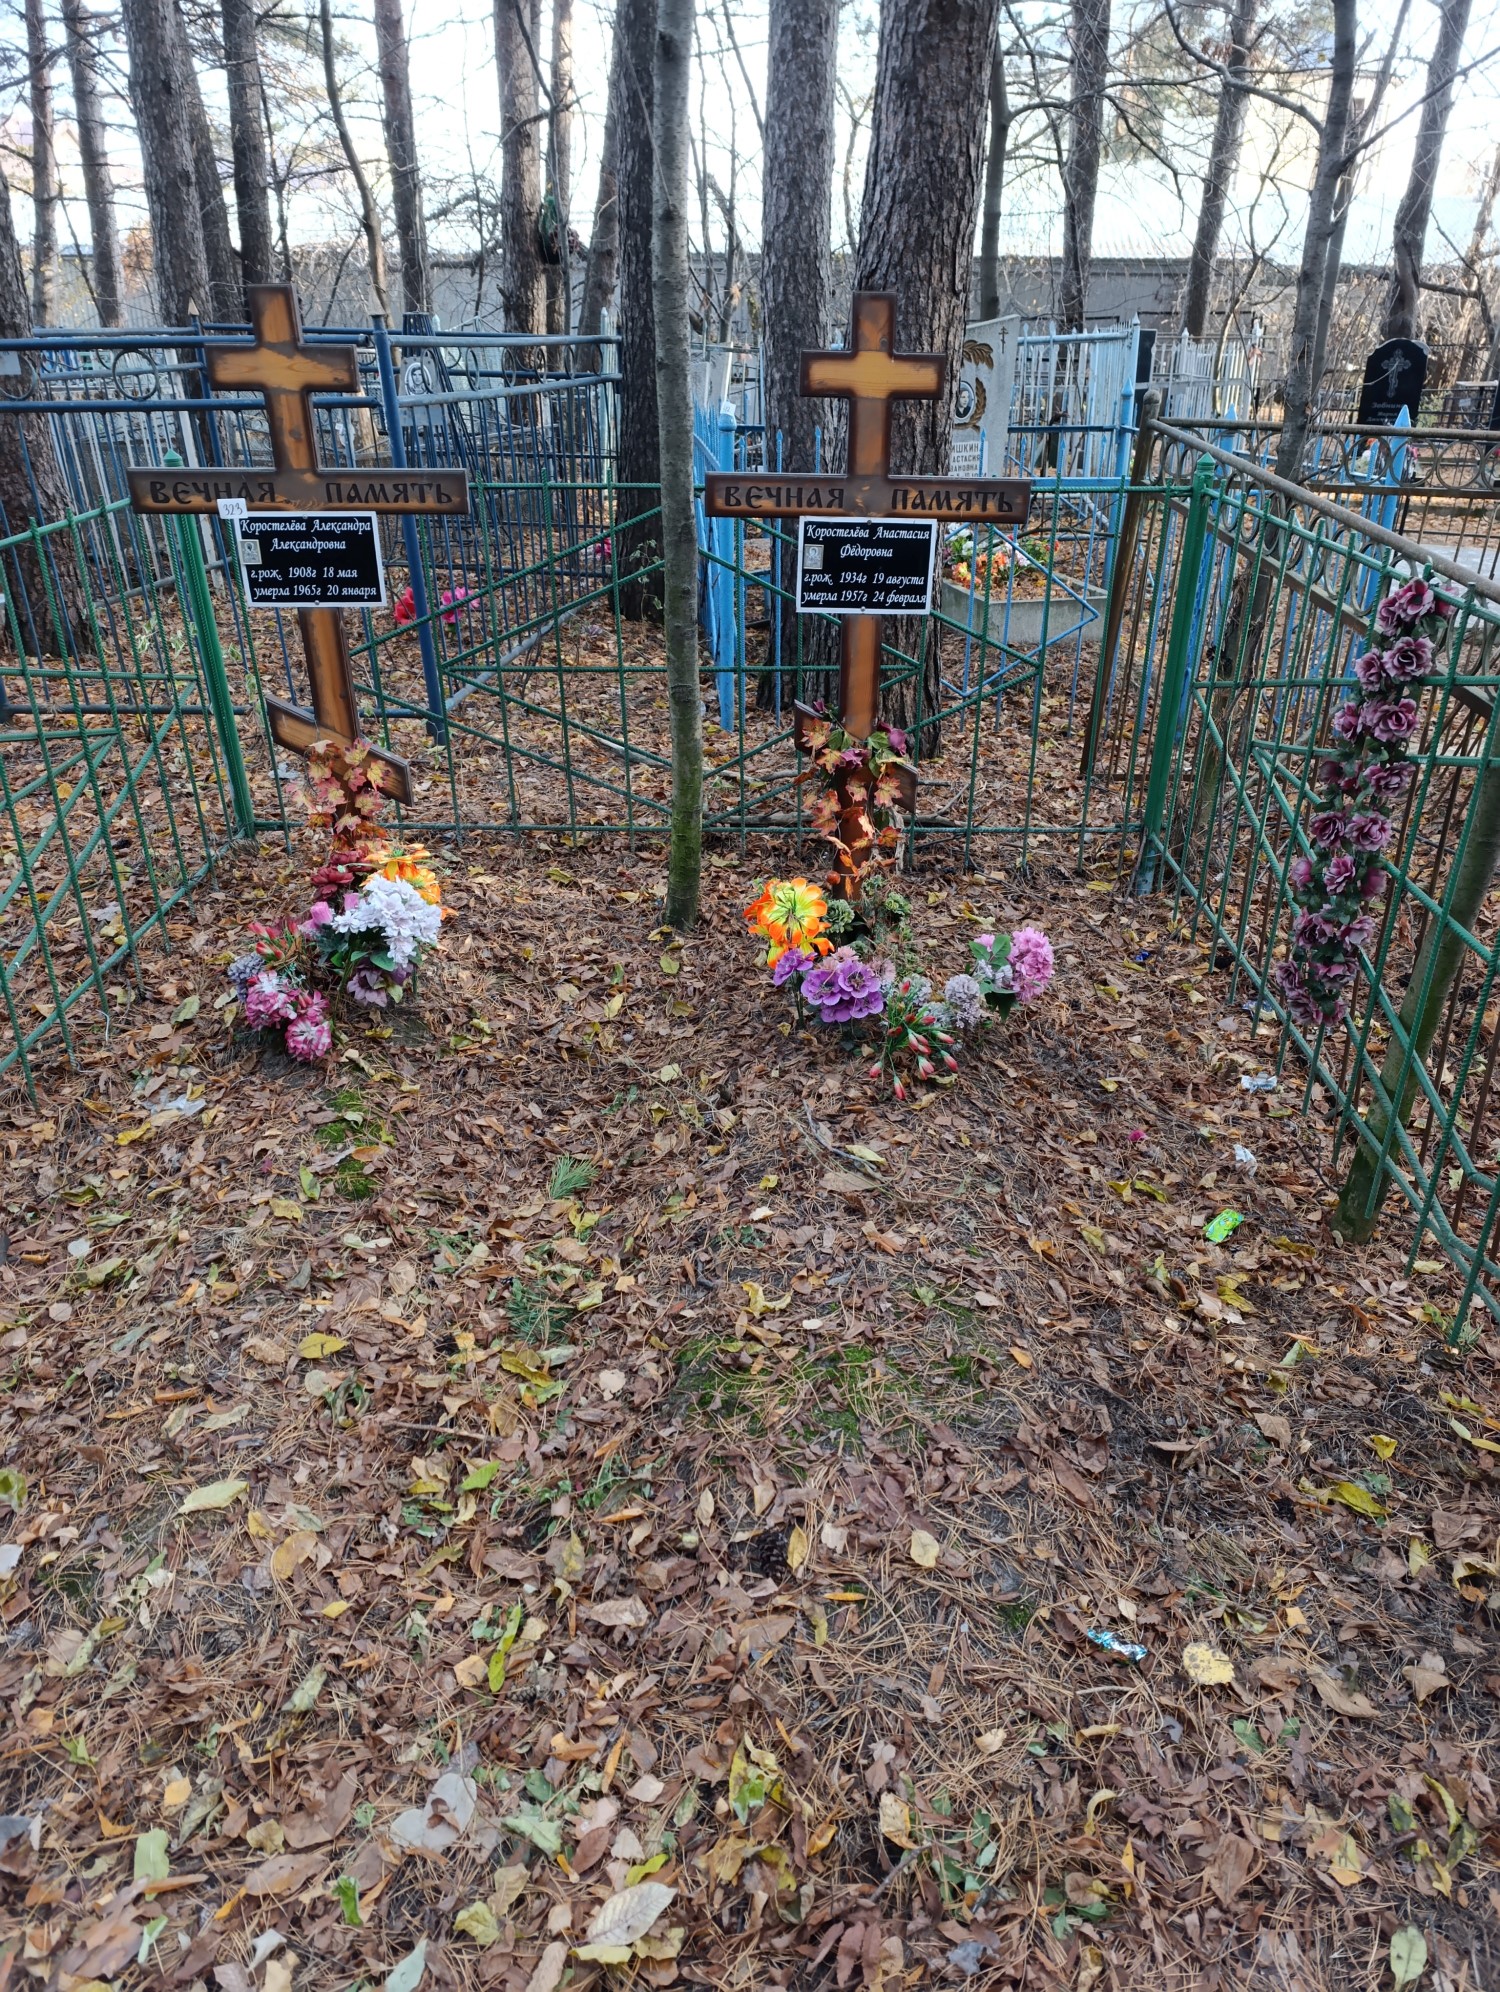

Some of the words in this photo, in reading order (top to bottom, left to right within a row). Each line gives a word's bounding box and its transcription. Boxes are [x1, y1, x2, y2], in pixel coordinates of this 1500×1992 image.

[951, 442, 979, 453] ИШКИН
[952, 454, 981, 463] АСТАСИЯ
[150, 481, 276, 505] ВЕЧНАЯ
[325, 482, 453, 504] ПАМЯТЬ
[724, 486, 844, 509] ВЕЧНАЯ
[891, 488, 1013, 513] ПАМЯТЬ
[223, 503, 243, 516] 323
[240, 519, 306, 535] Коростелёва
[311, 518, 371, 535] Александра
[806, 525, 869, 541] Коростелёва
[873, 526, 930, 540] Анастасия
[270, 536, 346, 553] Александровна
[840, 543, 893, 561] Фёдоровна
[288, 566, 317, 578] 1908г
[323, 566, 335, 578] 18
[336, 569, 358, 578] мая
[839, 572, 867, 583] 1934г
[872, 572, 885, 584] 19
[885, 575, 925, 588] августа
[253, 587, 290, 599] умерла
[293, 585, 321, 596] 1965г
[326, 584, 339, 596] 20
[341, 587, 377, 599] января
[801, 591, 837, 605] умерла
[840, 590, 867, 602] 1957г
[872, 590, 885, 602] 24
[885, 590, 927, 607] февраля
